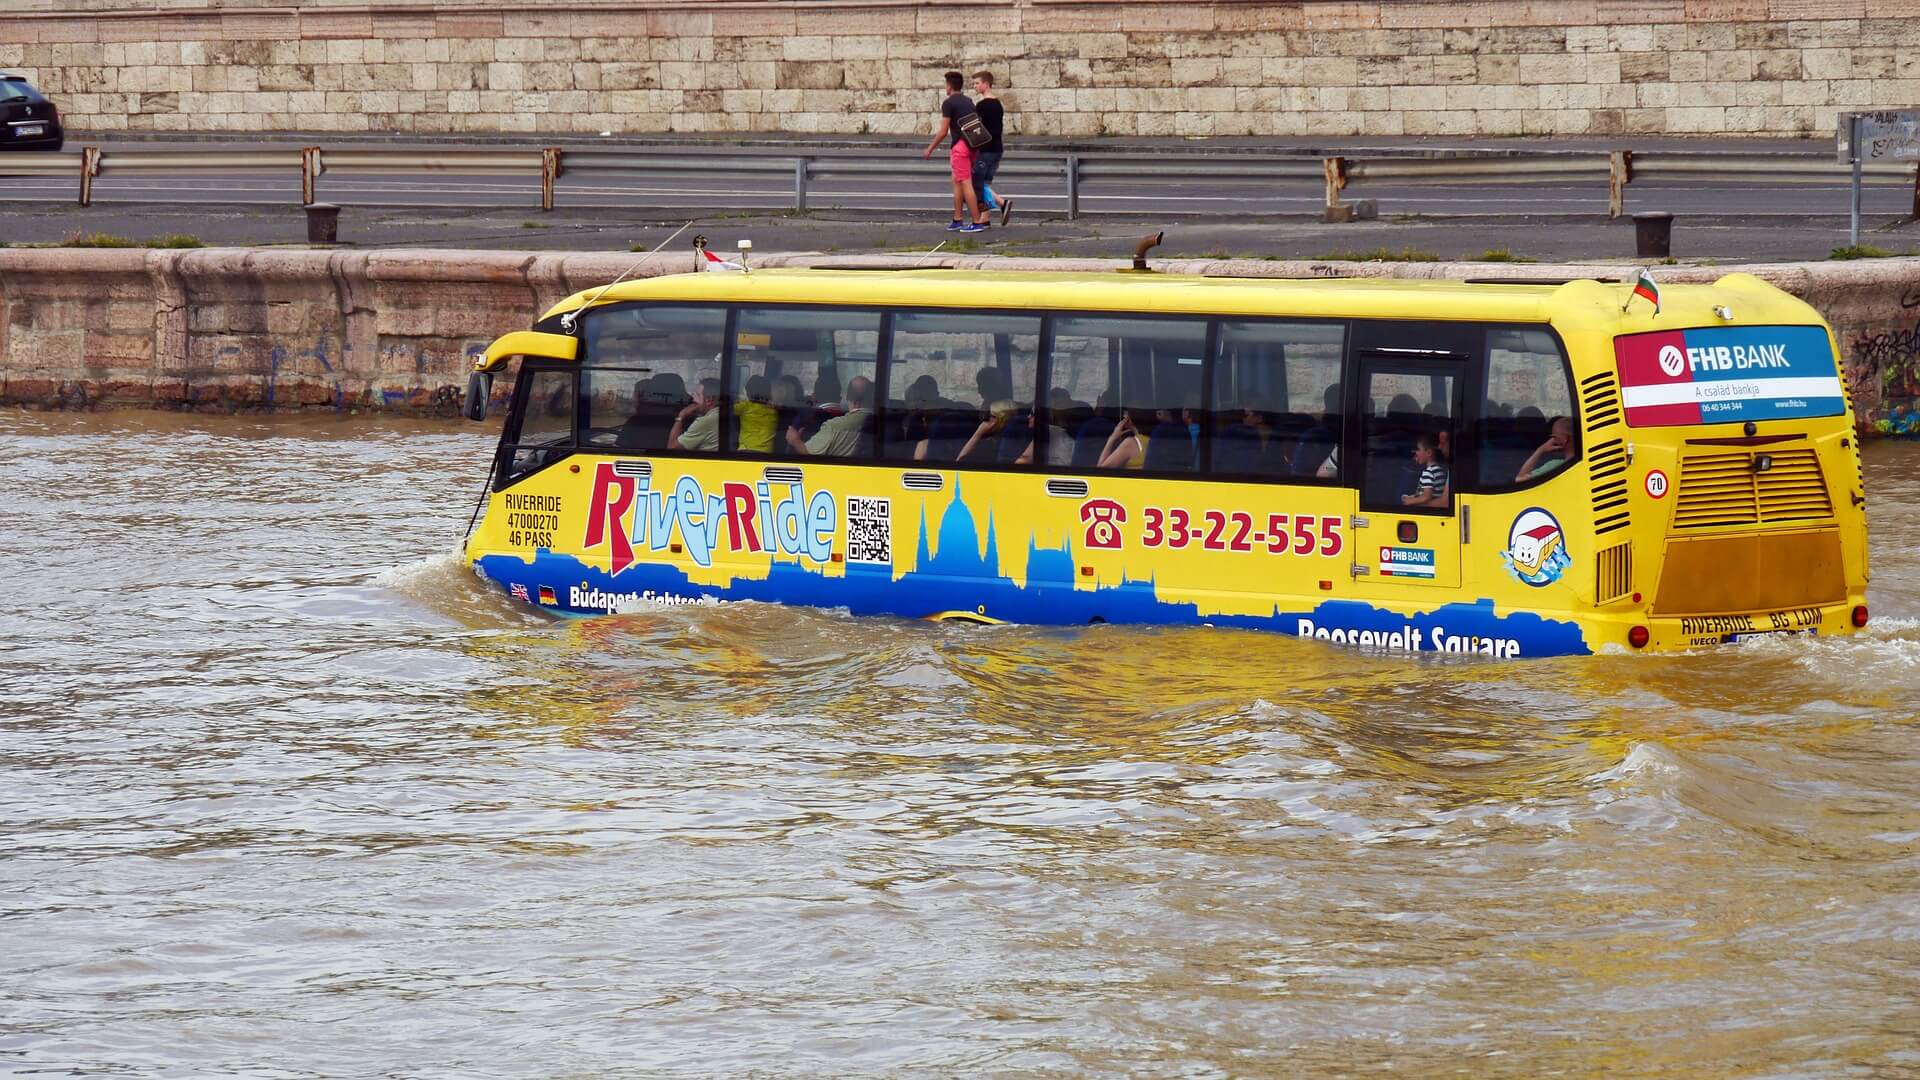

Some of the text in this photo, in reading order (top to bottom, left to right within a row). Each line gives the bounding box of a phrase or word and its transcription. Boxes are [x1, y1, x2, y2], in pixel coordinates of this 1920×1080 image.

[1686, 344, 1791, 372] FHB BANK
[1704, 384, 1730, 397] család
[1732, 383, 1760, 397] bankja
[1650, 477, 1663, 491] 70
[505, 494, 561, 512] RIVERRIDE
[507, 513, 558, 530] 47000270
[584, 463, 837, 577] RiverRide
[509, 531, 556, 548] 46 PASS.
[1142, 507, 1343, 557] 33-22-555
[1680, 607, 1823, 635] RIVERRIDE BG LOM
[1431, 627, 1521, 659] Square
[1690, 636, 1718, 646] IVECO
